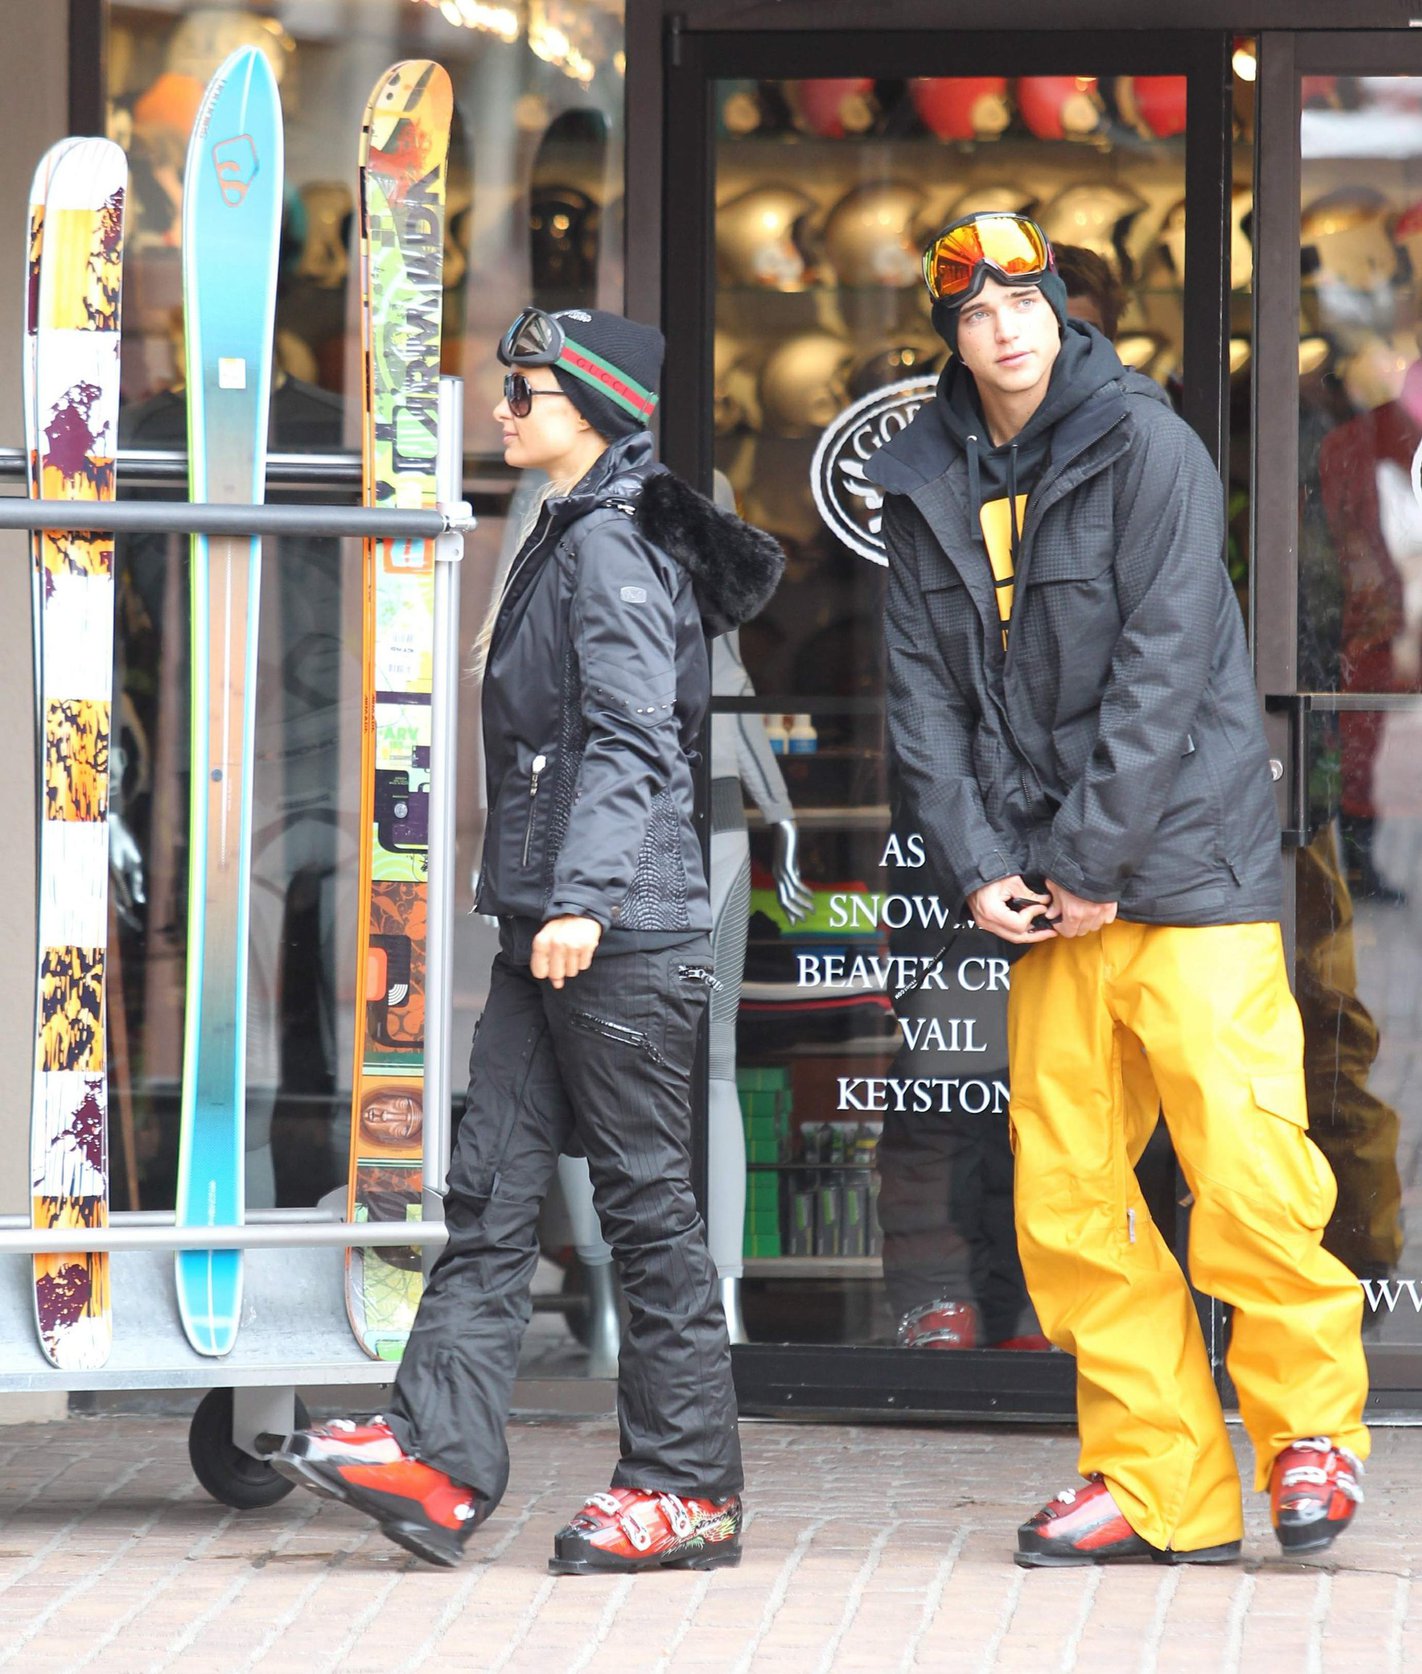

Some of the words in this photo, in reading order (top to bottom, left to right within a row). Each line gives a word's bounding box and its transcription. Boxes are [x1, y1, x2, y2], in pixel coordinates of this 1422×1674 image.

[576, 357, 629, 396] GUCCI
[879, 833, 926, 868] AS
[829, 895, 983, 929] SNOW
[797, 955, 949, 990] BEAVER
[898, 1018, 987, 1052] VAIL
